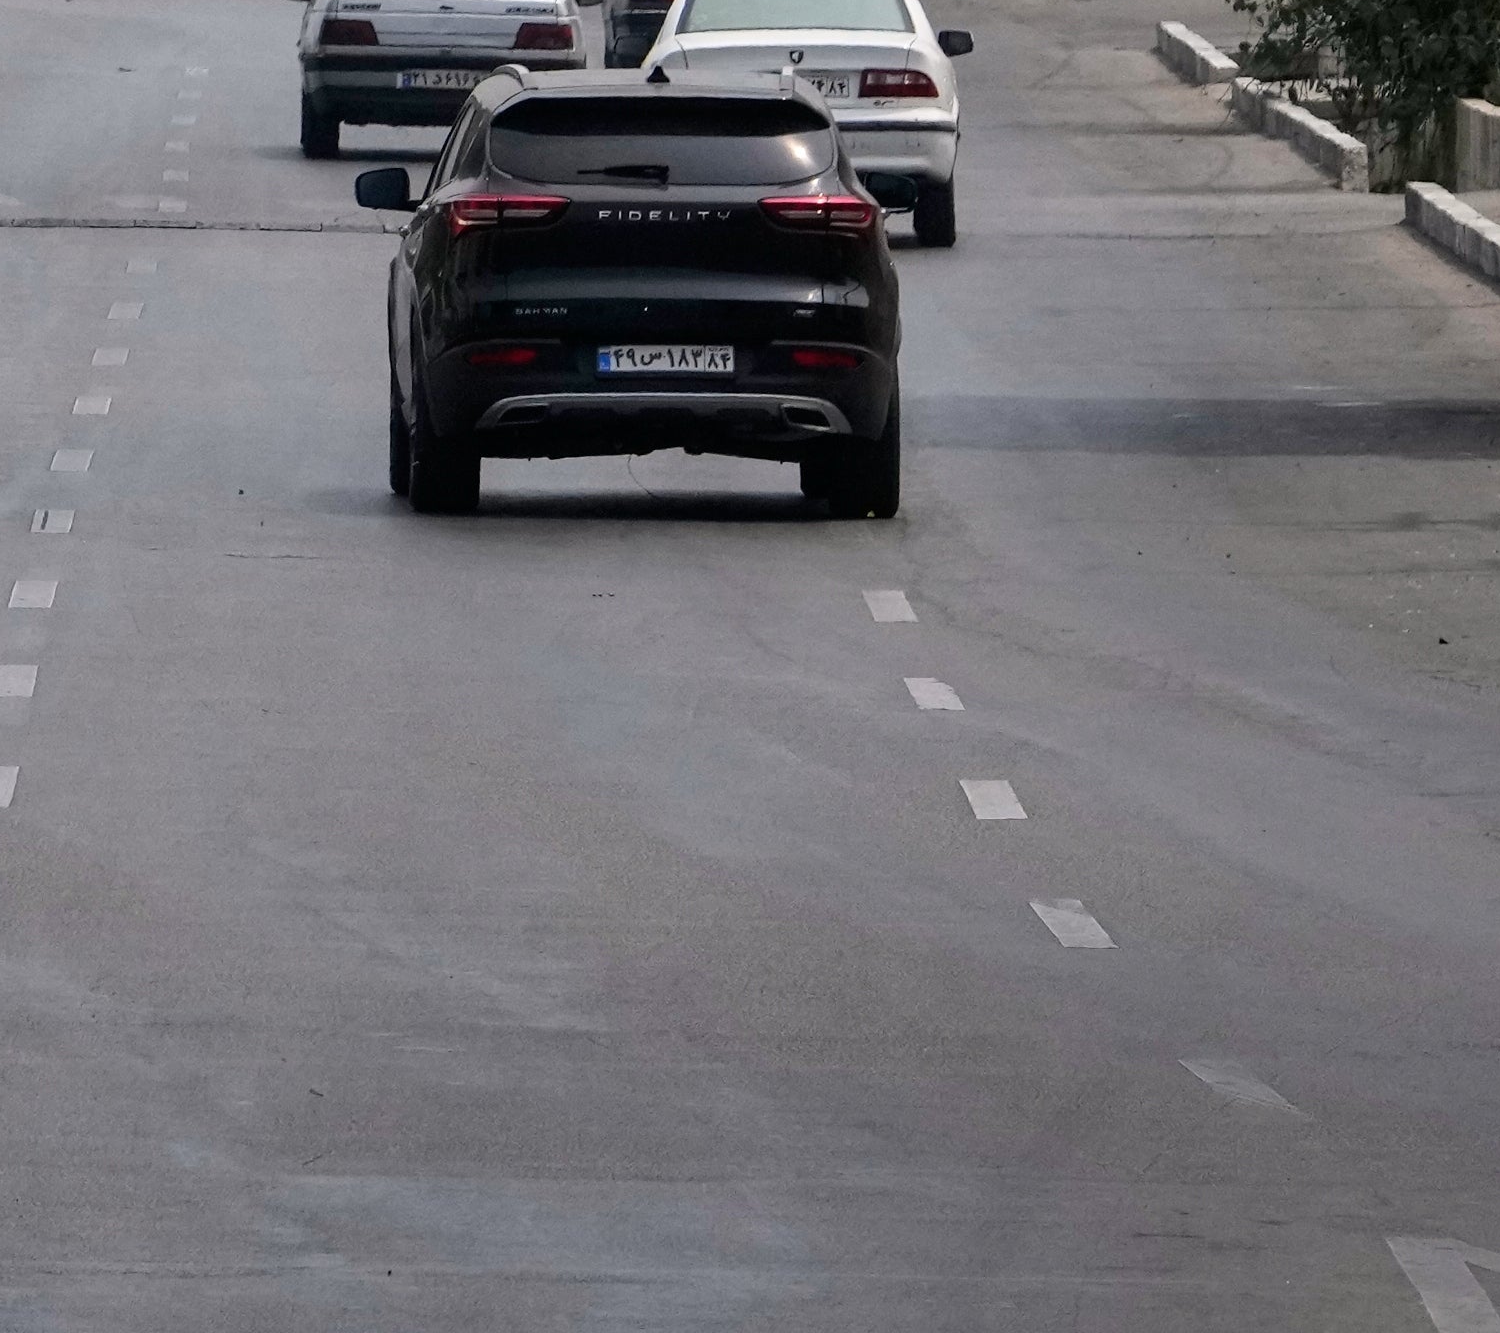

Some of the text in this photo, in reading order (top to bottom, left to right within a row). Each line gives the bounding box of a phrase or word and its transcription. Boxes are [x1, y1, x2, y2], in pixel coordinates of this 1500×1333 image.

[598, 209, 732, 221] FIDELITY
[515, 307, 568, 316] BAHMAN
[613, 346, 732, 370] ۴۹ س ۱۸۳ ۸۴
